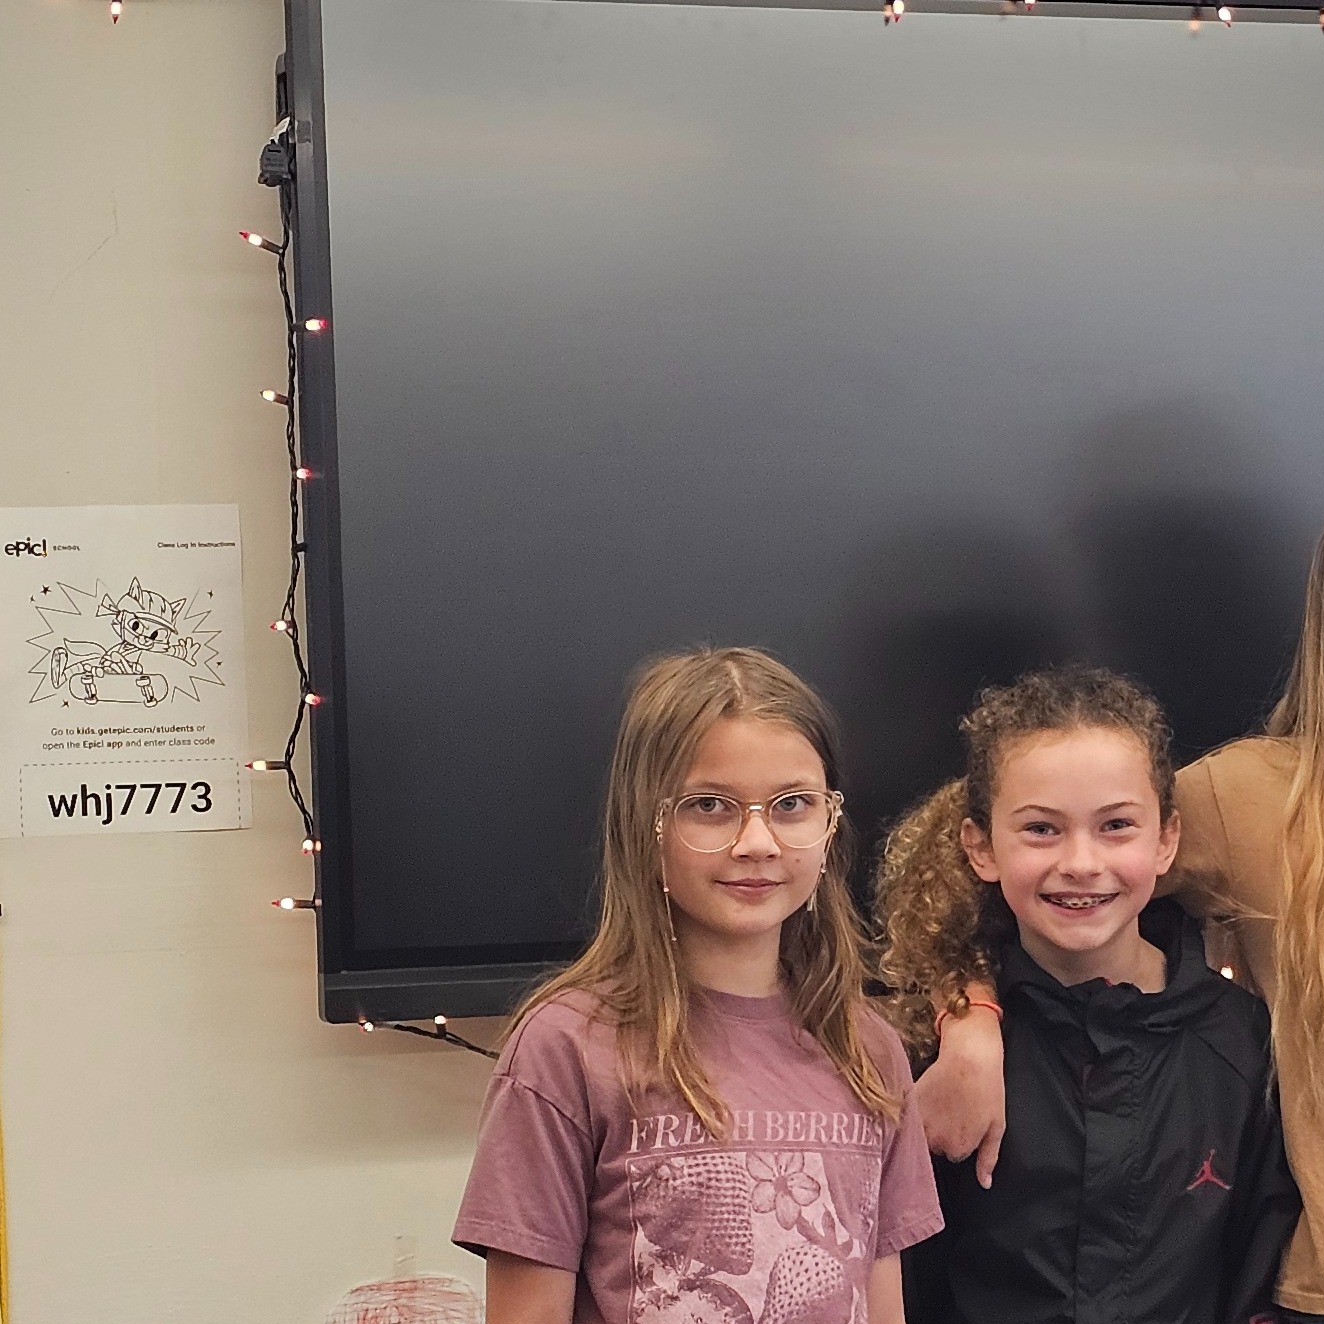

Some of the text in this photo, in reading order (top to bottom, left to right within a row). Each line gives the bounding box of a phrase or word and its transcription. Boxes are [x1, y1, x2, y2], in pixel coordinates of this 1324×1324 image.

[4, 536, 47, 557] epic!
[51, 728, 63, 736] Go
[42, 742, 64, 750] open
[67, 740, 80, 748] the
[106, 740, 123, 749] app
[126, 739, 142, 747] and
[144, 739, 166, 747] enter
[168, 737, 191, 746] class
[194, 737, 215, 745] code
[47, 781, 212, 825] whj7773
[628, 1110, 883, 1153] FREH BERRIES
